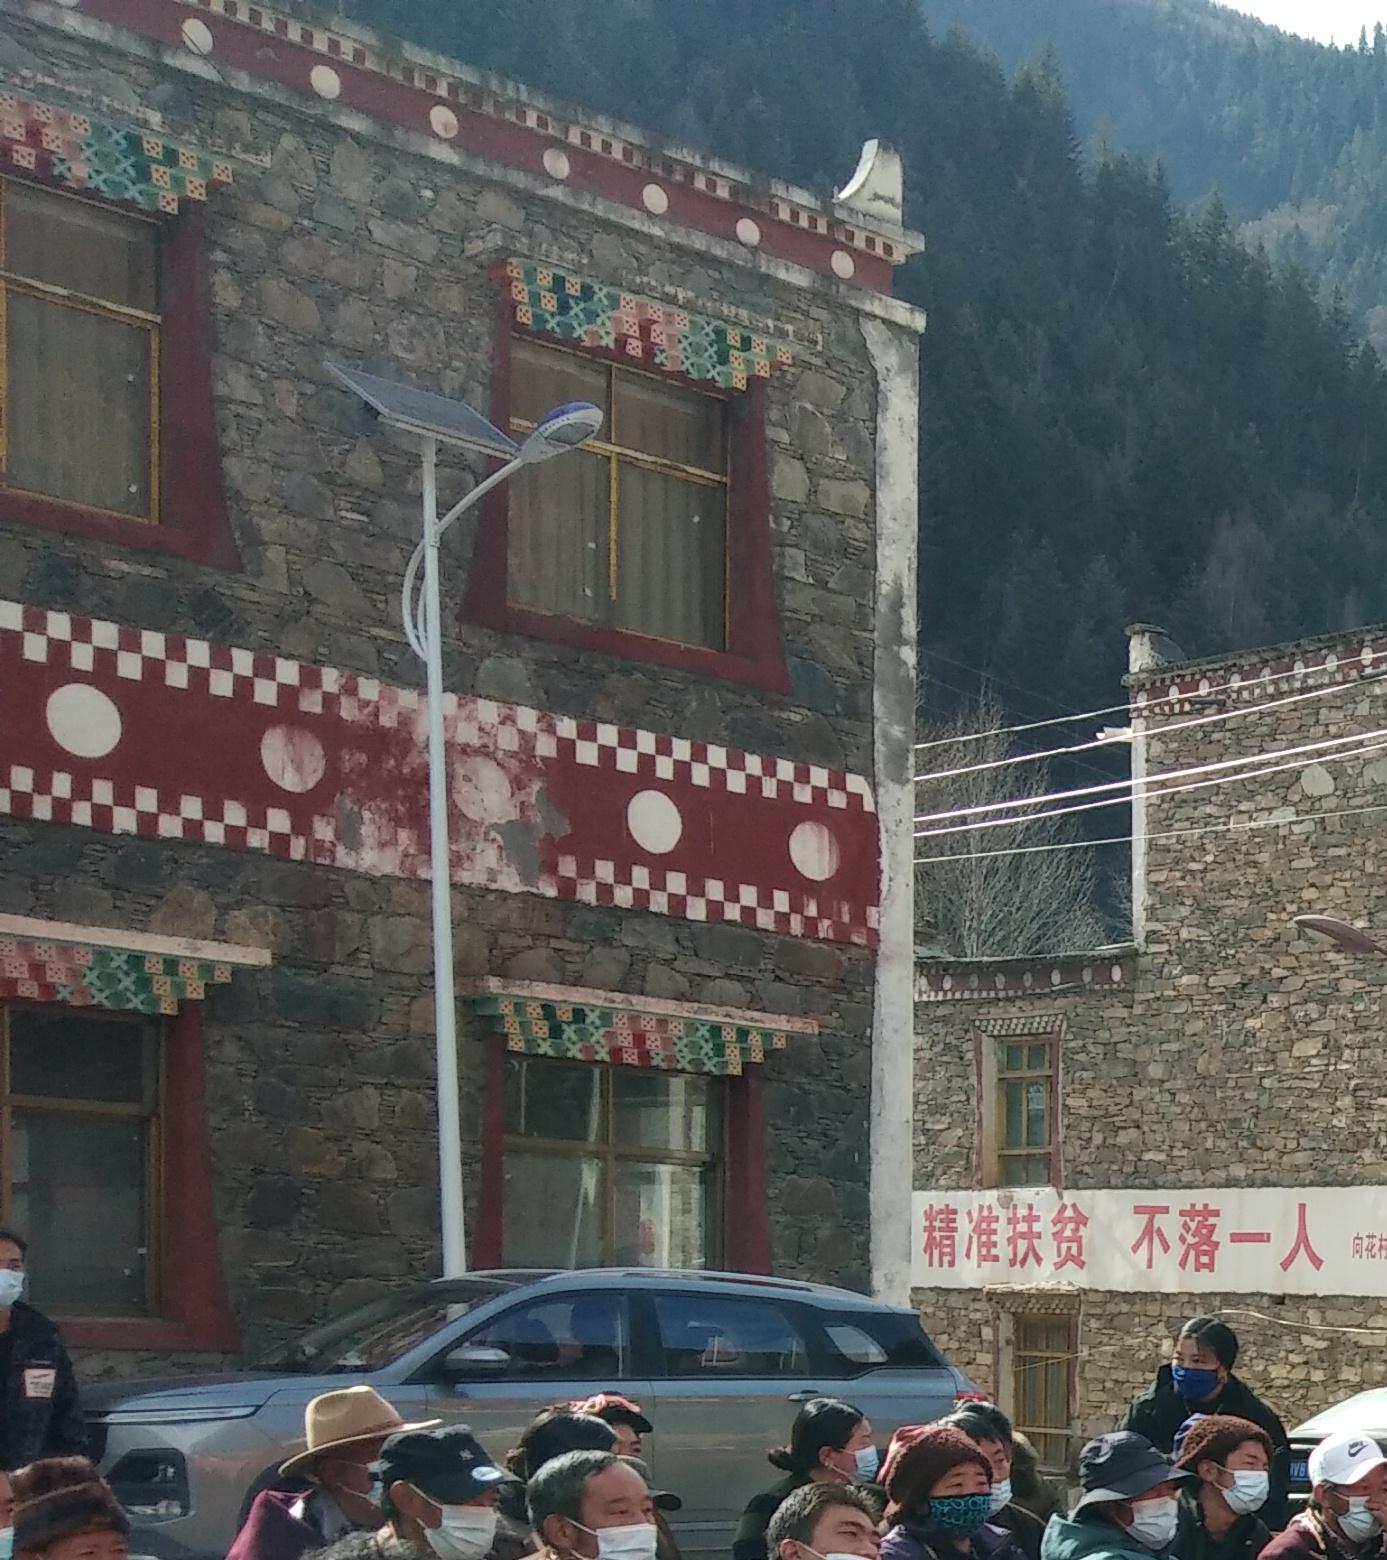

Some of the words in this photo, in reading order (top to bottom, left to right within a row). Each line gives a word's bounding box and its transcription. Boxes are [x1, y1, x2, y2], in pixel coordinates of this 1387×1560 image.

[922, 1202, 1089, 1271] 精准扶贫
[1130, 1202, 1325, 1273] 不落一人
